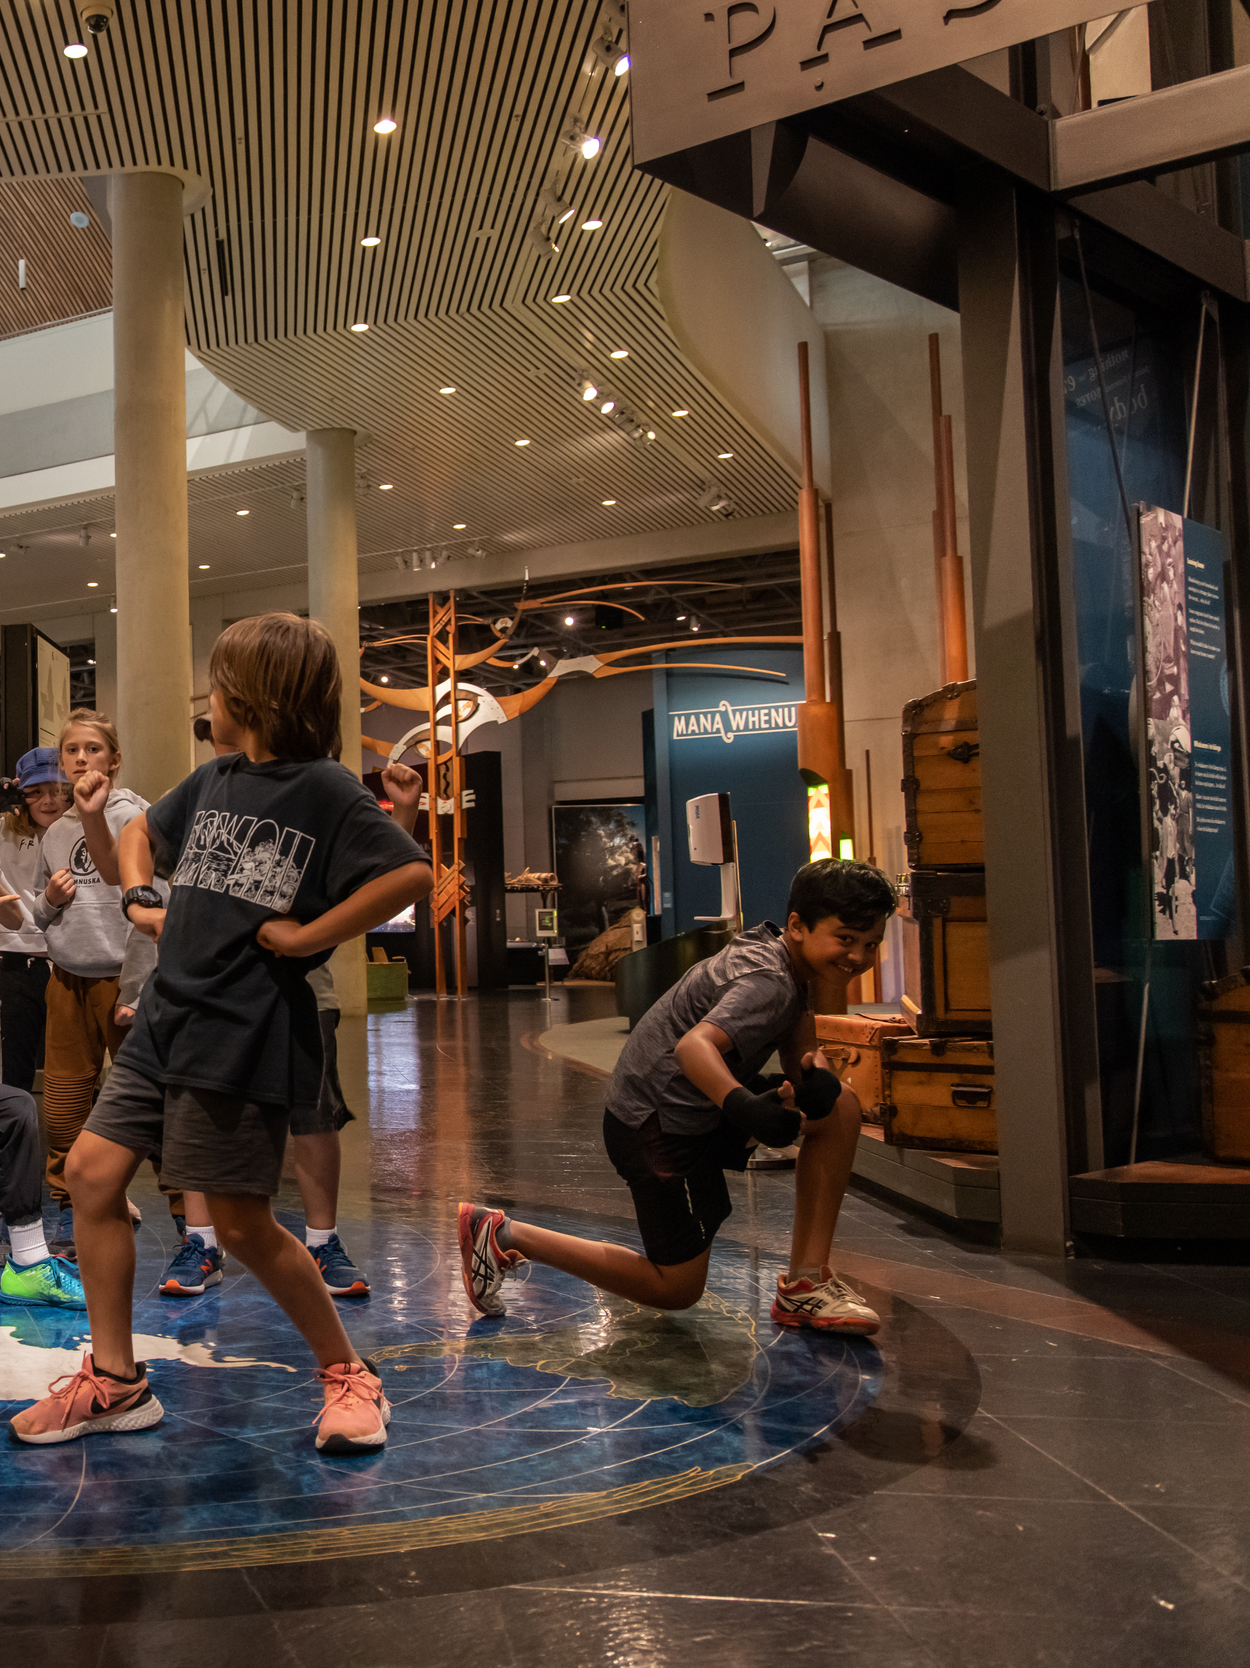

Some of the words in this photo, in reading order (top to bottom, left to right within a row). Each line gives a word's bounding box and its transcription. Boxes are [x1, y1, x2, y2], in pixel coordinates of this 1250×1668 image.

[703, 0, 1003, 102] PA
[673, 713, 723, 735] MANA
[730, 707, 797, 731] WHENU
